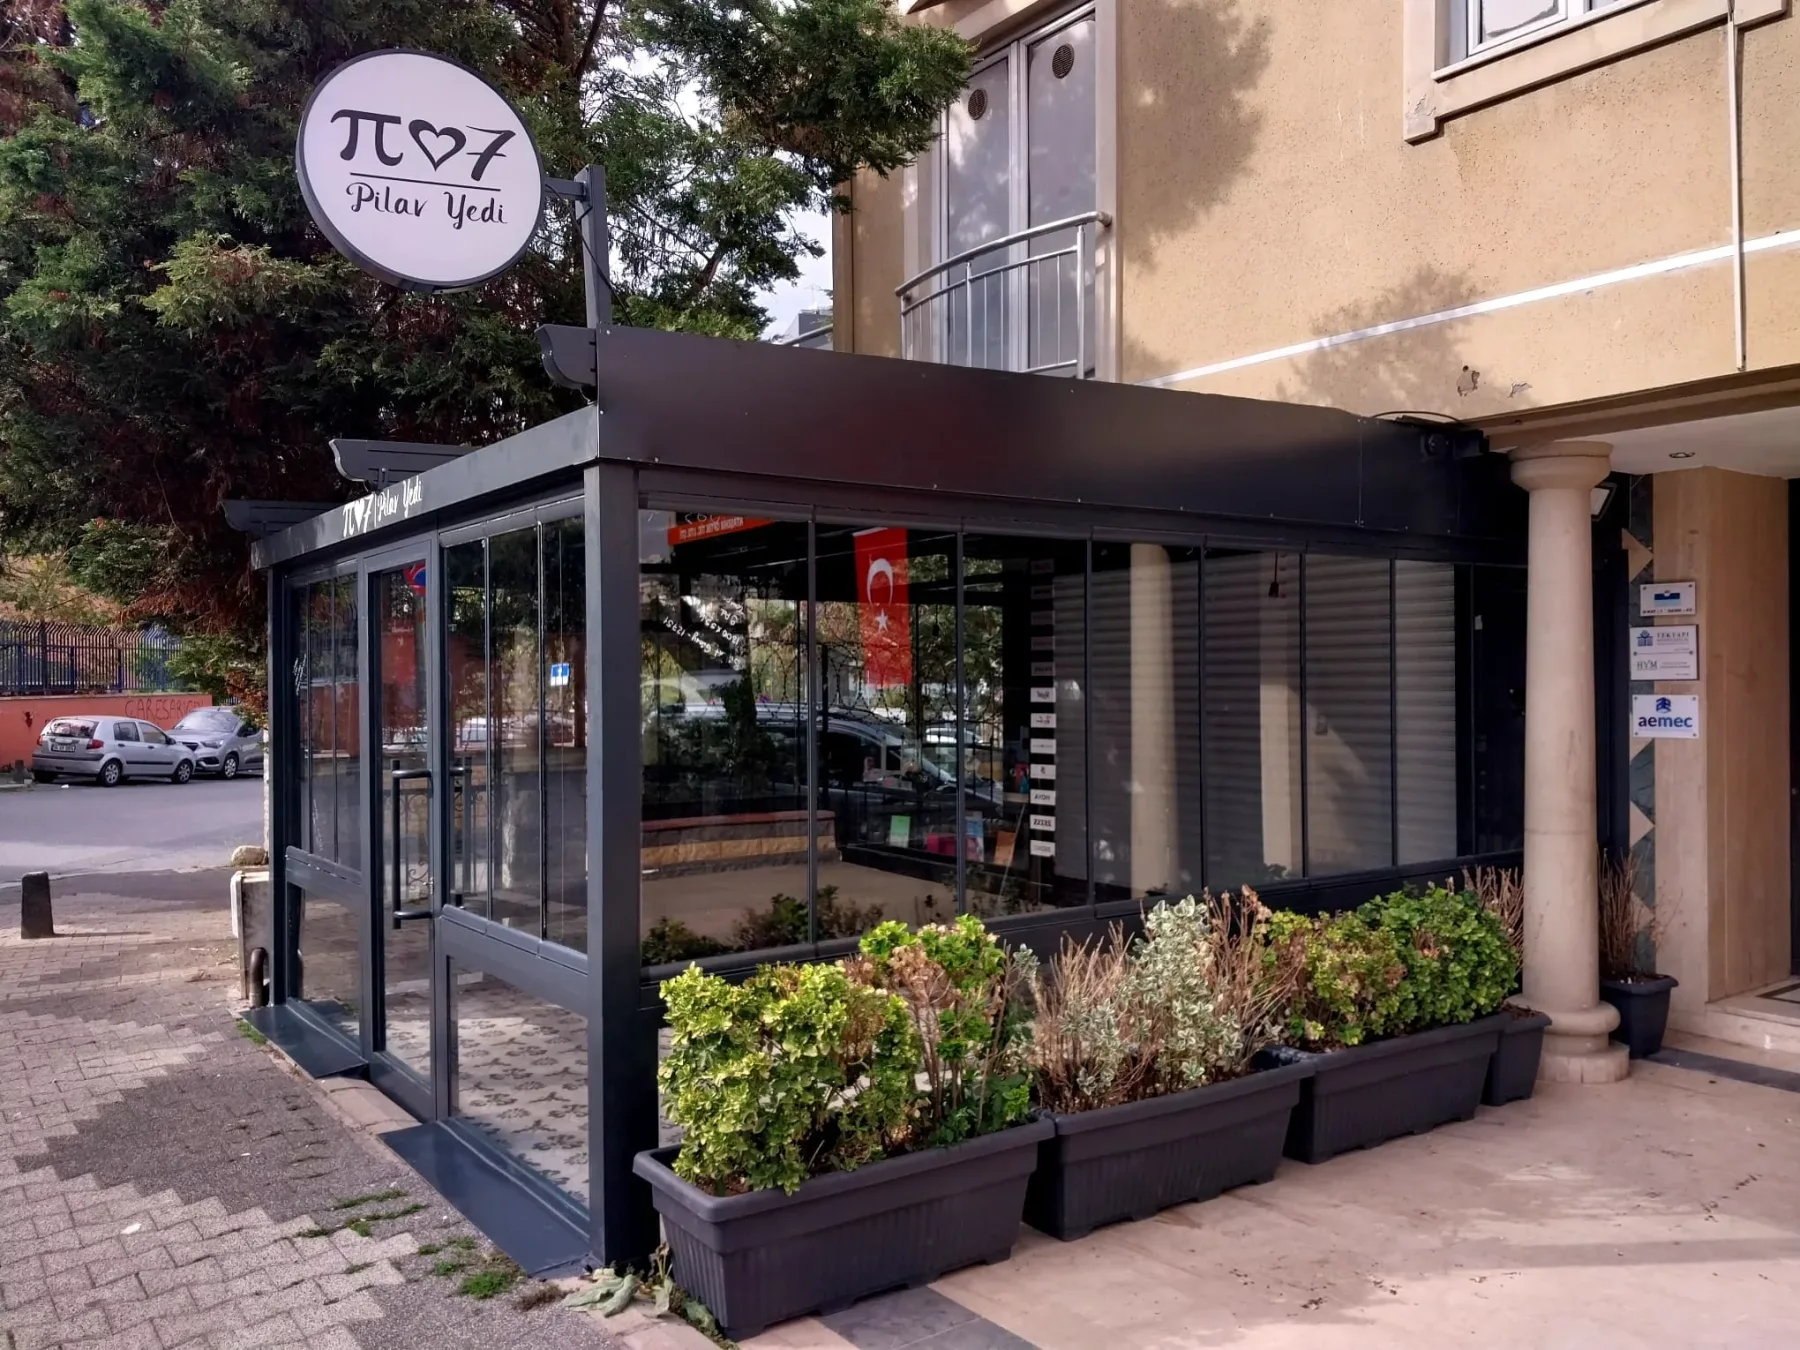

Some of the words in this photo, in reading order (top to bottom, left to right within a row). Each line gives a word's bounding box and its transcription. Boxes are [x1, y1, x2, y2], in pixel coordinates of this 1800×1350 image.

[345, 181, 428, 217] Pilav
[443, 191, 508, 230] Yedi
[402, 475, 422, 519] Yedi
[1638, 715, 1693, 728] aemec
